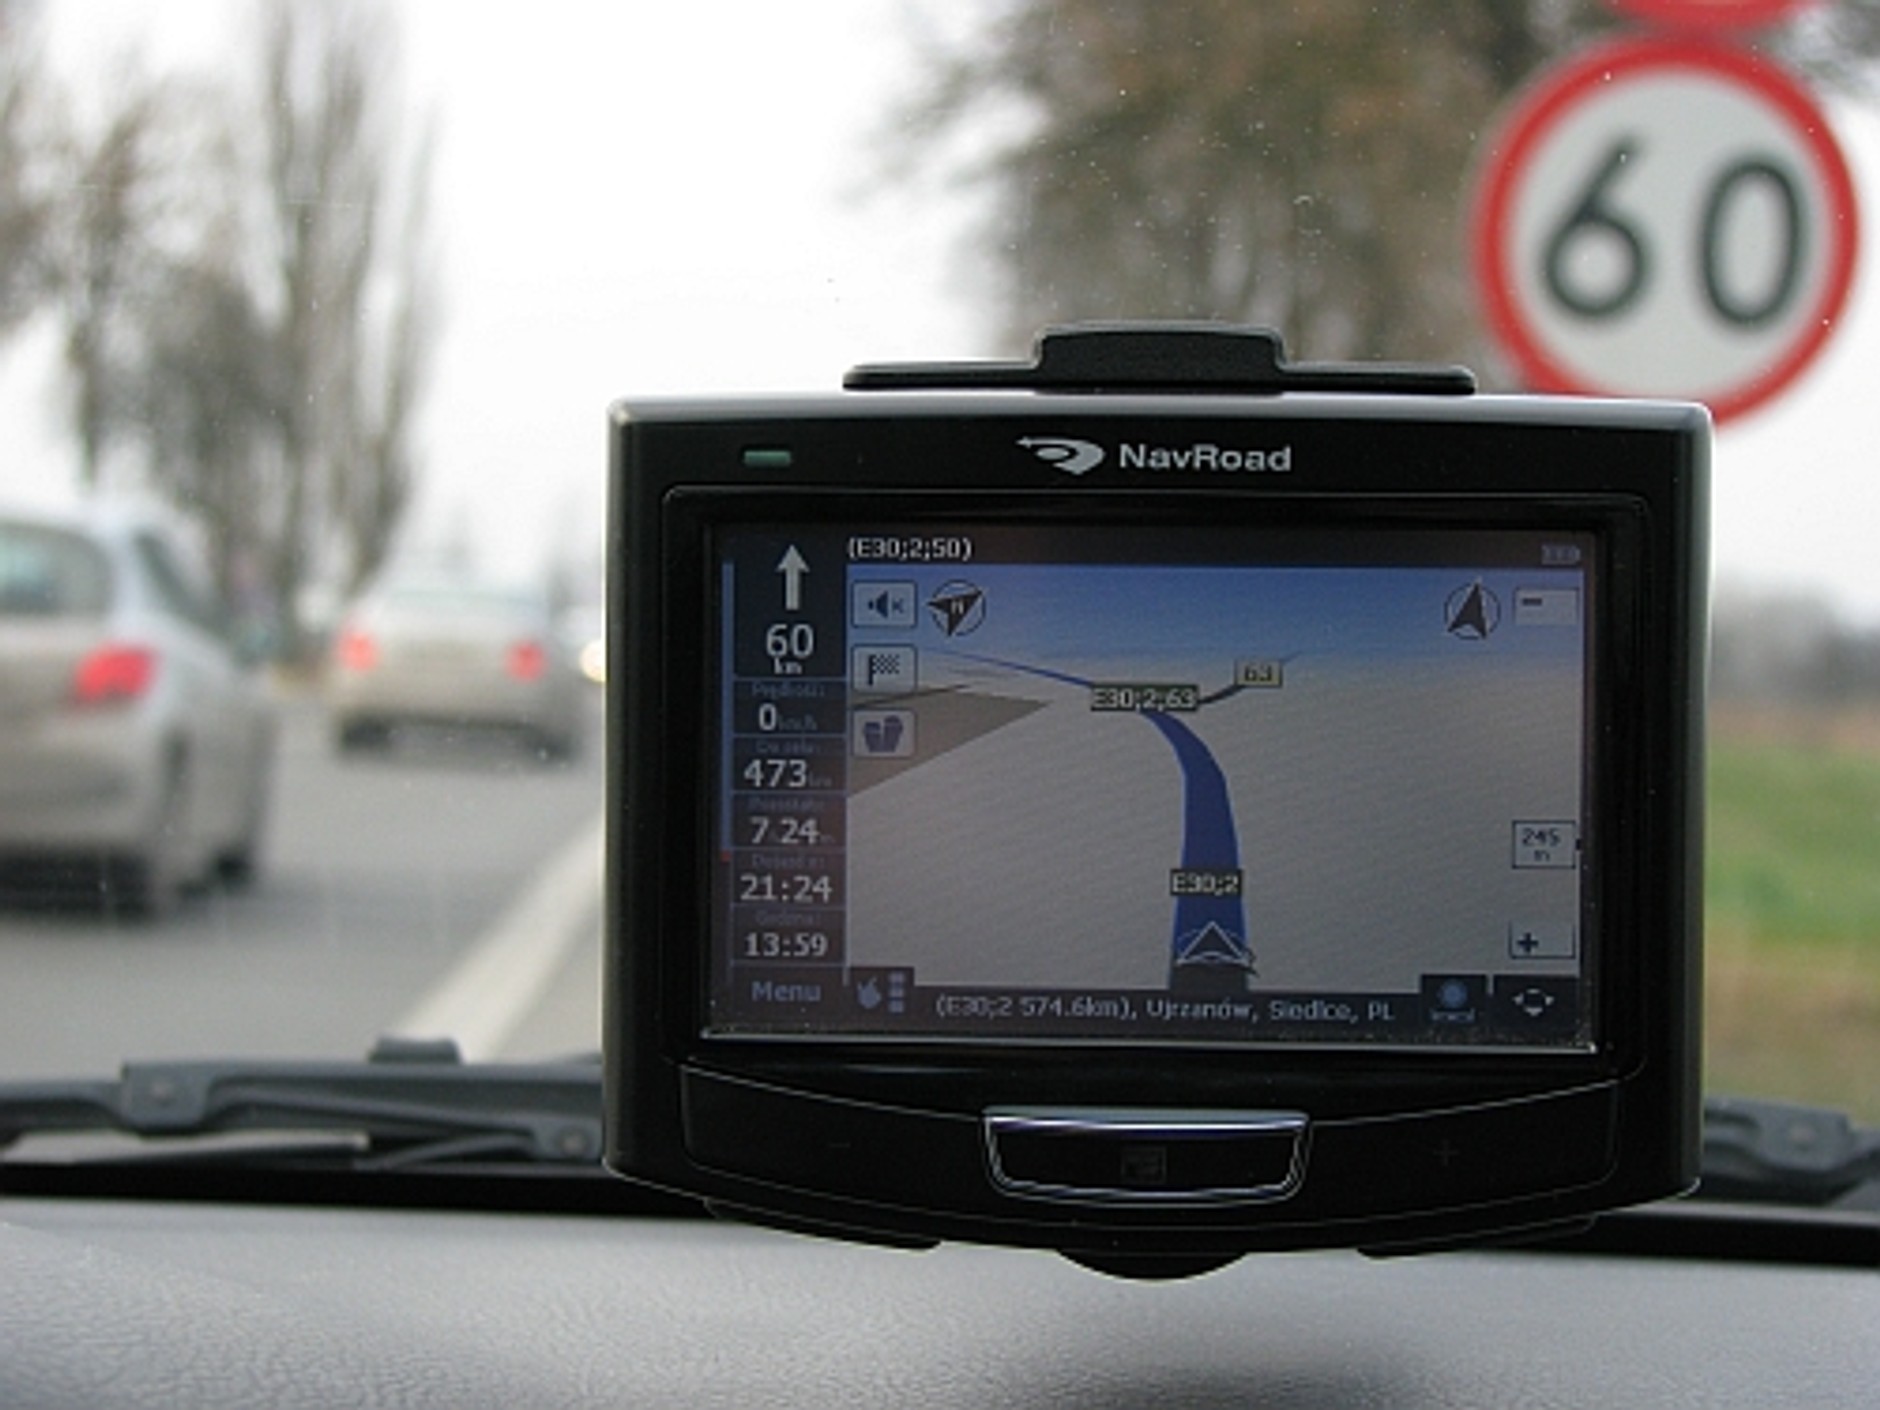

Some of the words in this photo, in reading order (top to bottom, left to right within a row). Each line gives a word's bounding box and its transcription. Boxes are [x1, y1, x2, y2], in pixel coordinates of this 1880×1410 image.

[1539, 133, 1808, 334] 60
[1118, 443, 1292, 472] NavRoad
[848, 537, 973, 562] (E30;2;50)
[766, 623, 815, 658] 60
[1244, 664, 1272, 682] 63
[758, 702, 777, 731] 0
[743, 758, 808, 788] 473
[1521, 827, 1561, 847] 245
[740, 873, 832, 902] 21:24
[745, 932, 829, 957] 13:59
[751, 981, 822, 1002] Menu
[1367, 1000, 1396, 1021] PL
